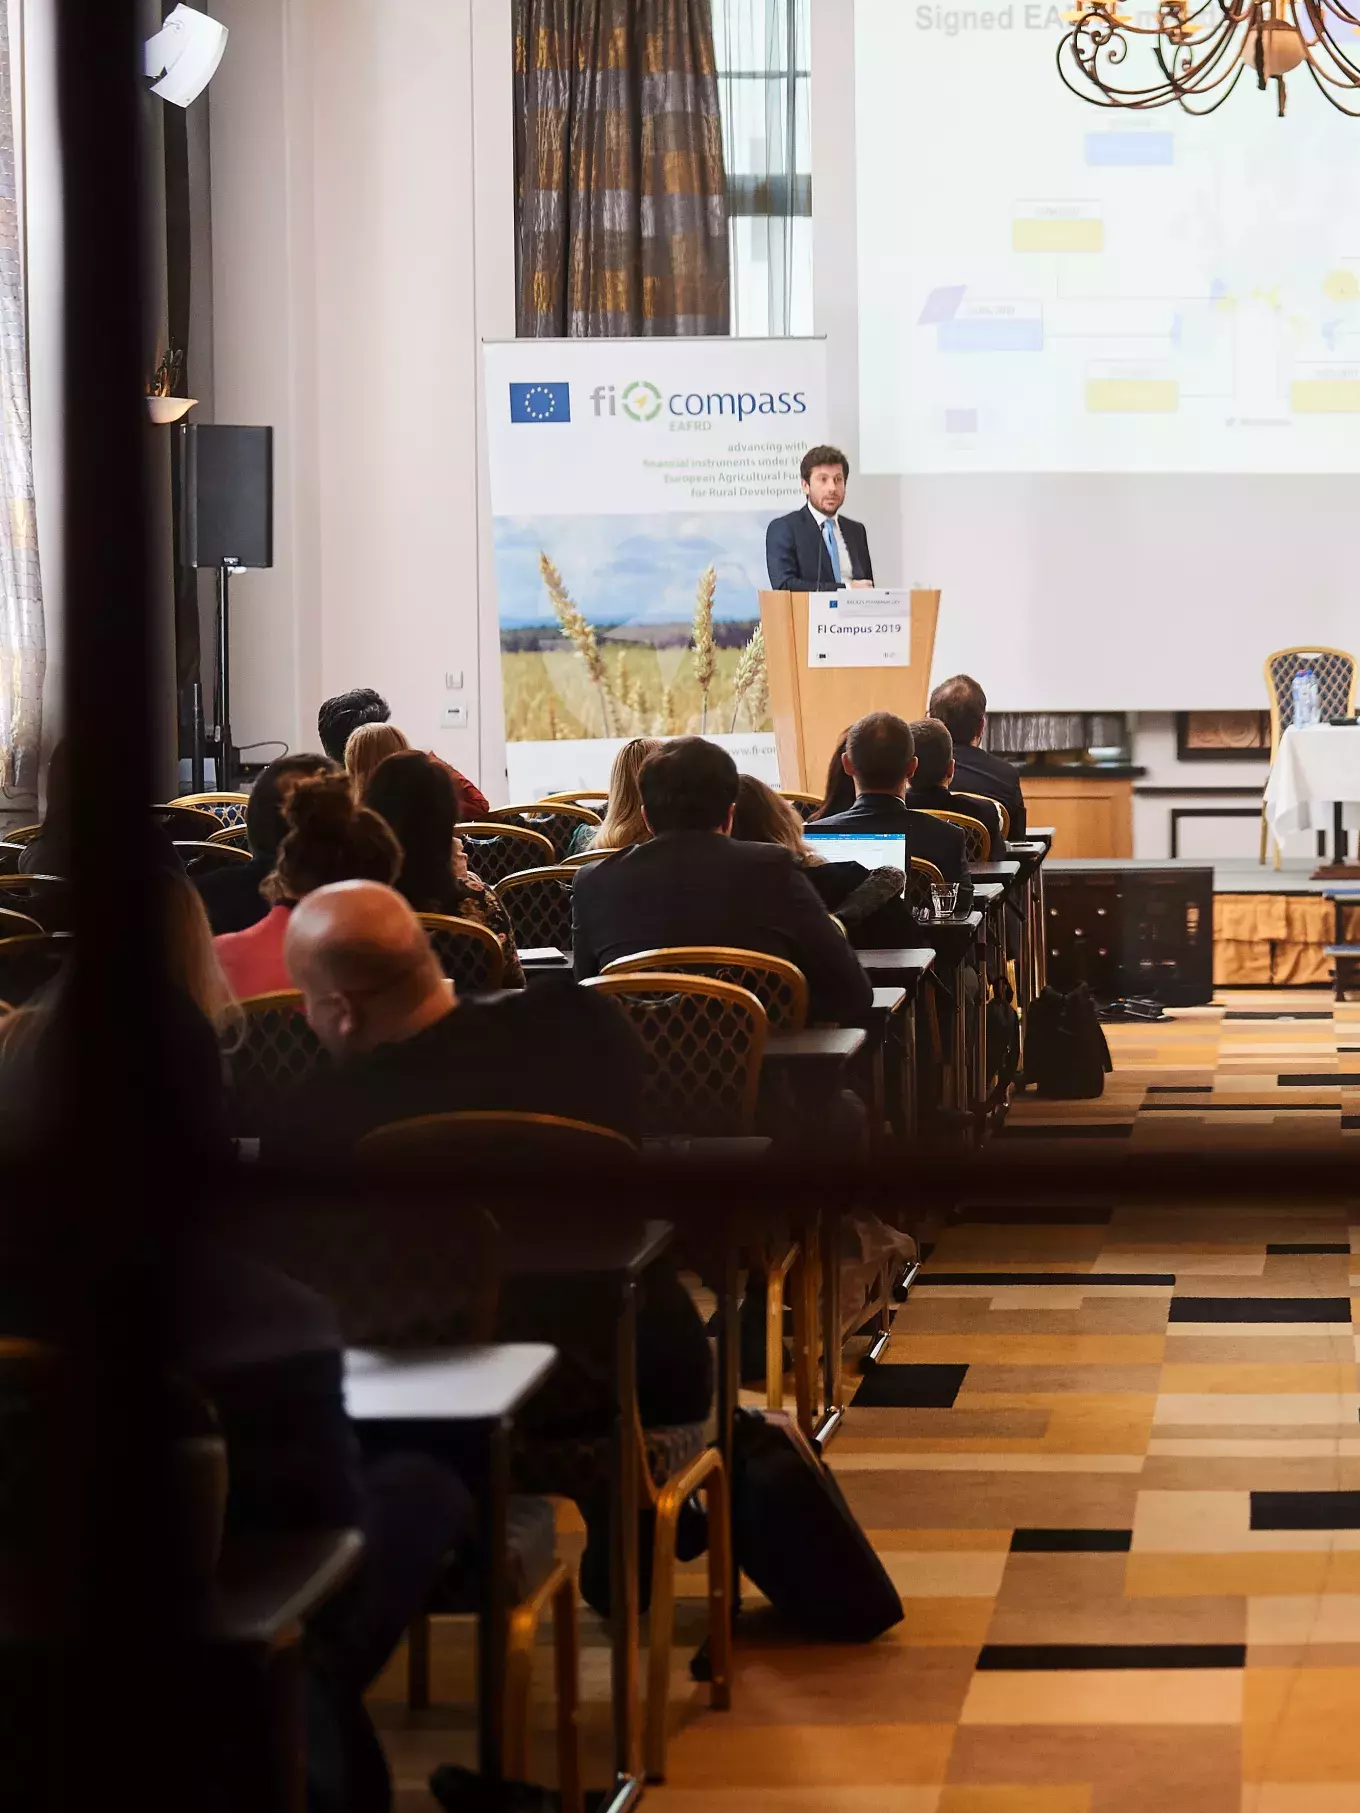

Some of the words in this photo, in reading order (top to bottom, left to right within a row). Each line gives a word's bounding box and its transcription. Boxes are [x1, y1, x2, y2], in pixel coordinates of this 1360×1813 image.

[915, 5, 1013, 36] Signed
[590, 385, 616, 416] fi
[668, 391, 807, 422] compass
[669, 420, 712, 432] EAFRD
[727, 441, 783, 453] advancing
[785, 440, 808, 452] with
[691, 456, 756, 468] instruments
[758, 456, 789, 467] under
[664, 473, 715, 486] European
[718, 472, 781, 485] Agricultural
[691, 487, 708, 498] for
[709, 486, 736, 498] Rural
[817, 624, 827, 634] FI
[829, 624, 873, 636] Campus
[874, 623, 902, 633] 2019
